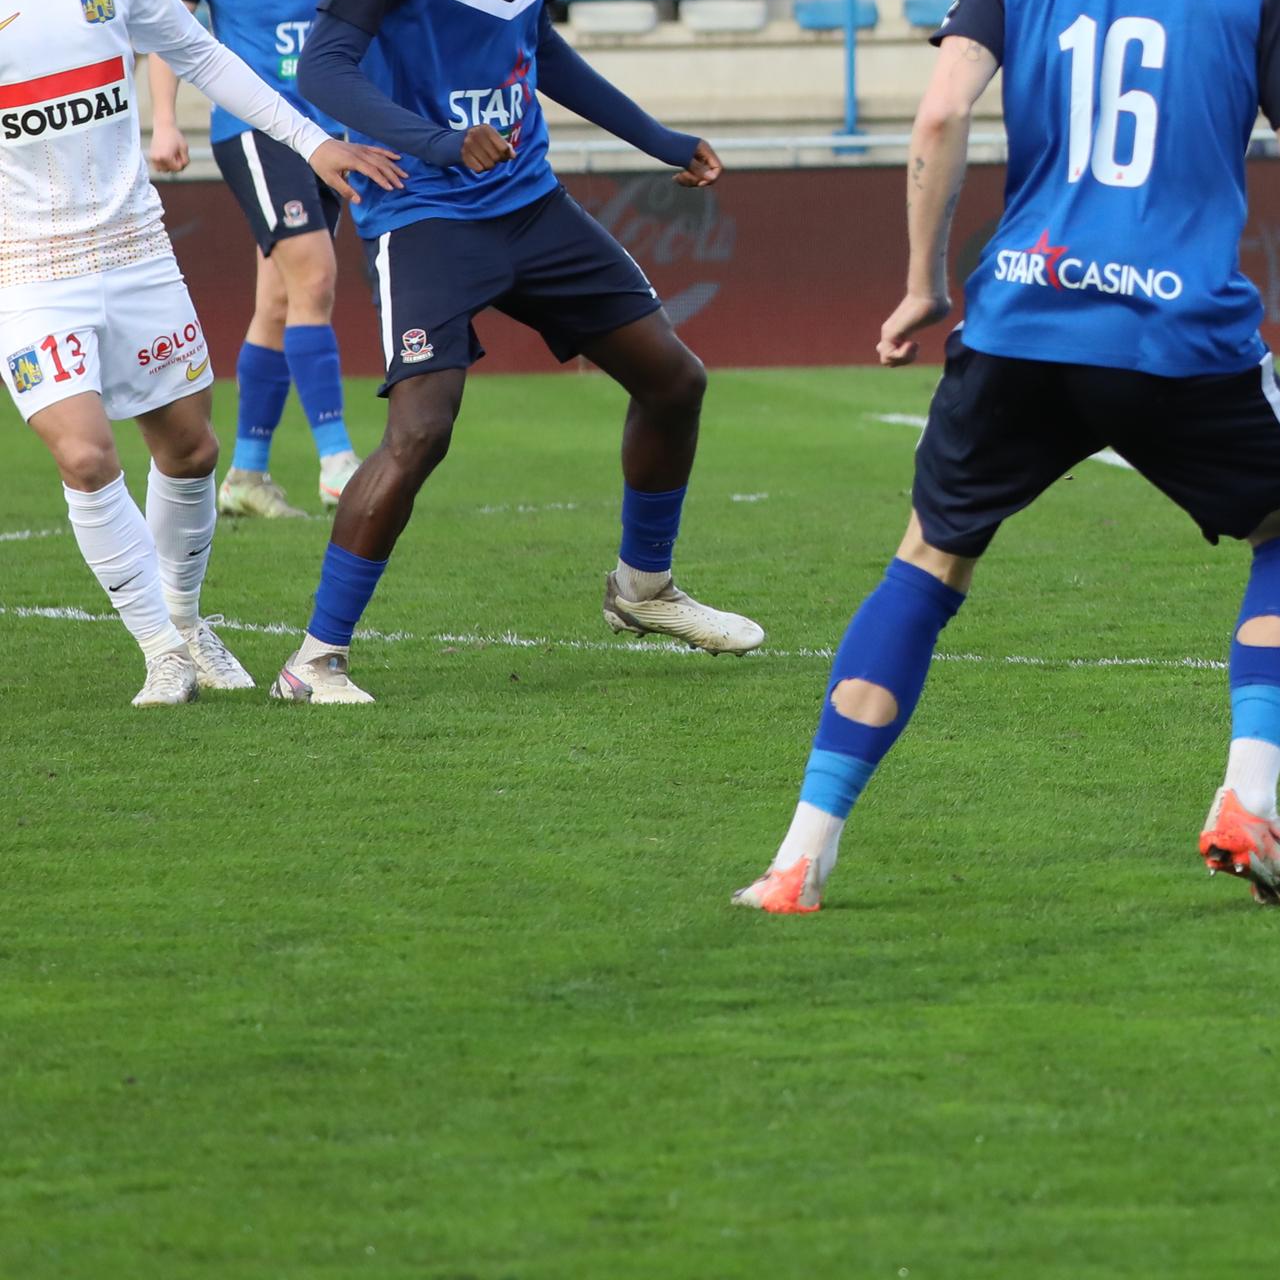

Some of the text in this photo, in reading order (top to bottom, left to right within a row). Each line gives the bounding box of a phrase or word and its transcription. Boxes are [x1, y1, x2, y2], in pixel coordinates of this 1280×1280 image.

[275, 20, 312, 55] ST
[2, 86, 129, 140] SOUDAL
[448, 83, 523, 131] STAR
[1058, 14, 1167, 188] 16
[994, 249, 1183, 300] STAR CASINO
[40, 334, 86, 383] 13
